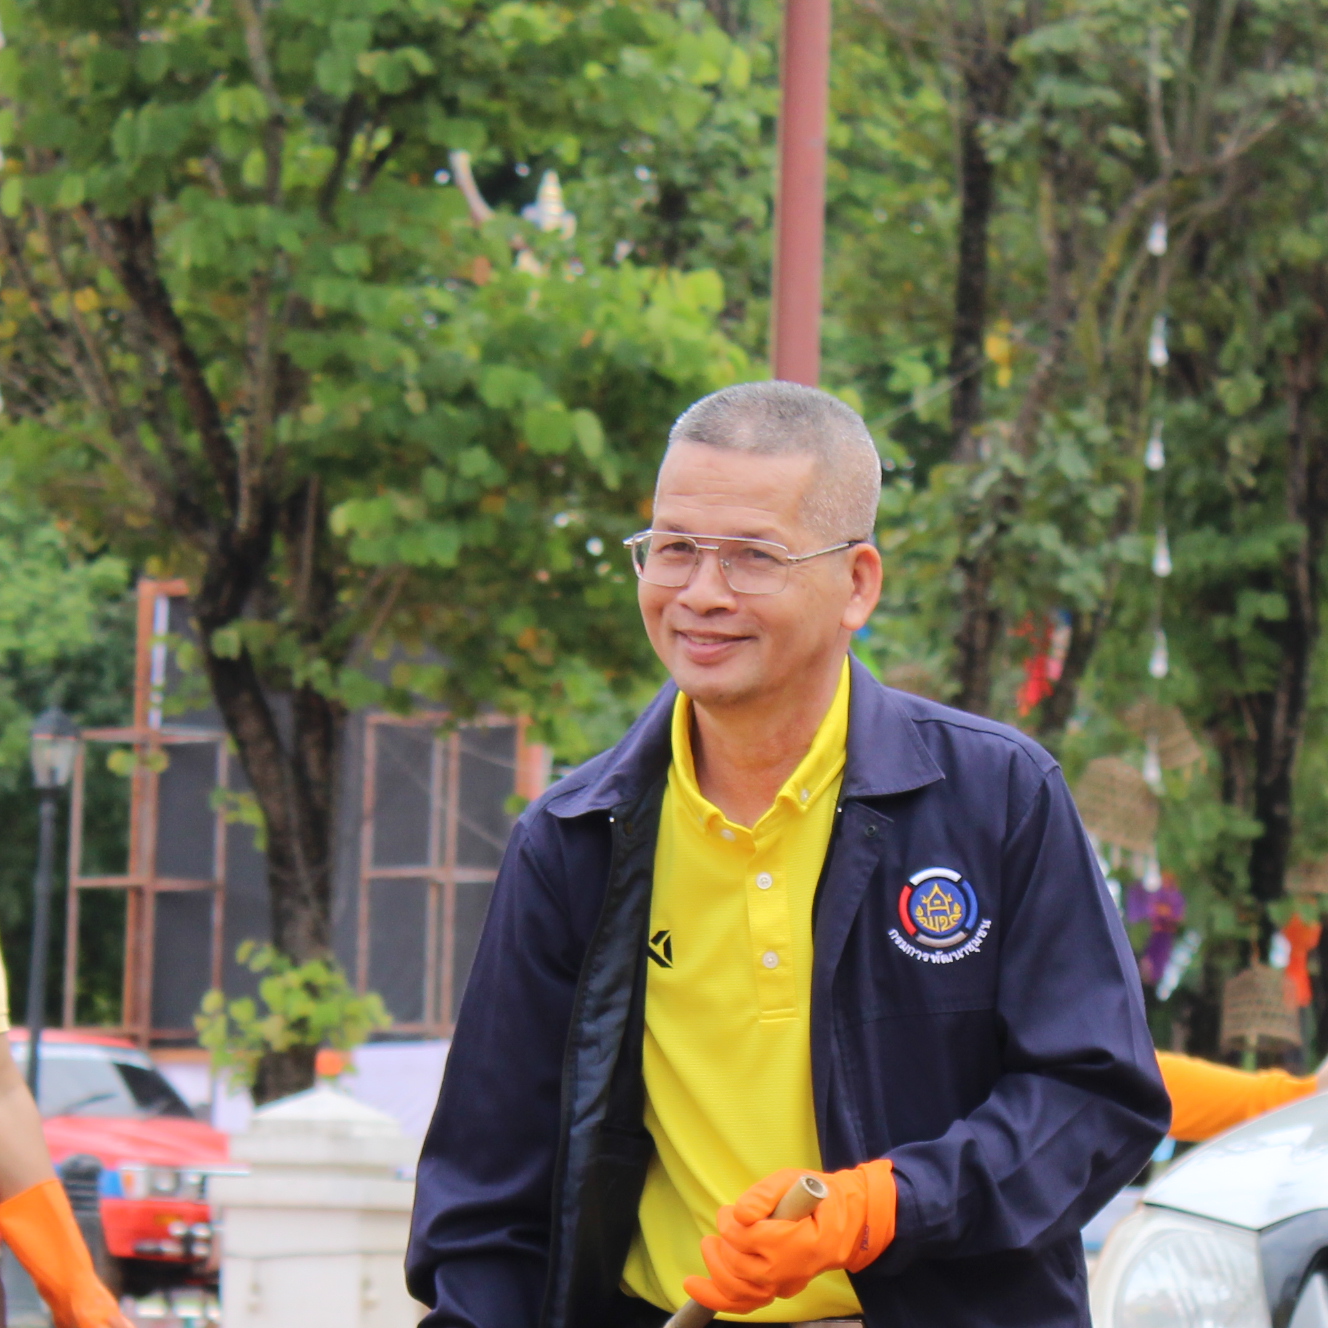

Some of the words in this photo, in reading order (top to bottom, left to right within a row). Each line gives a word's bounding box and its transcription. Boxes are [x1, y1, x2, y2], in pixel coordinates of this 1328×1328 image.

[887, 917, 992, 964] กรมการพัฒนาชุมชน
